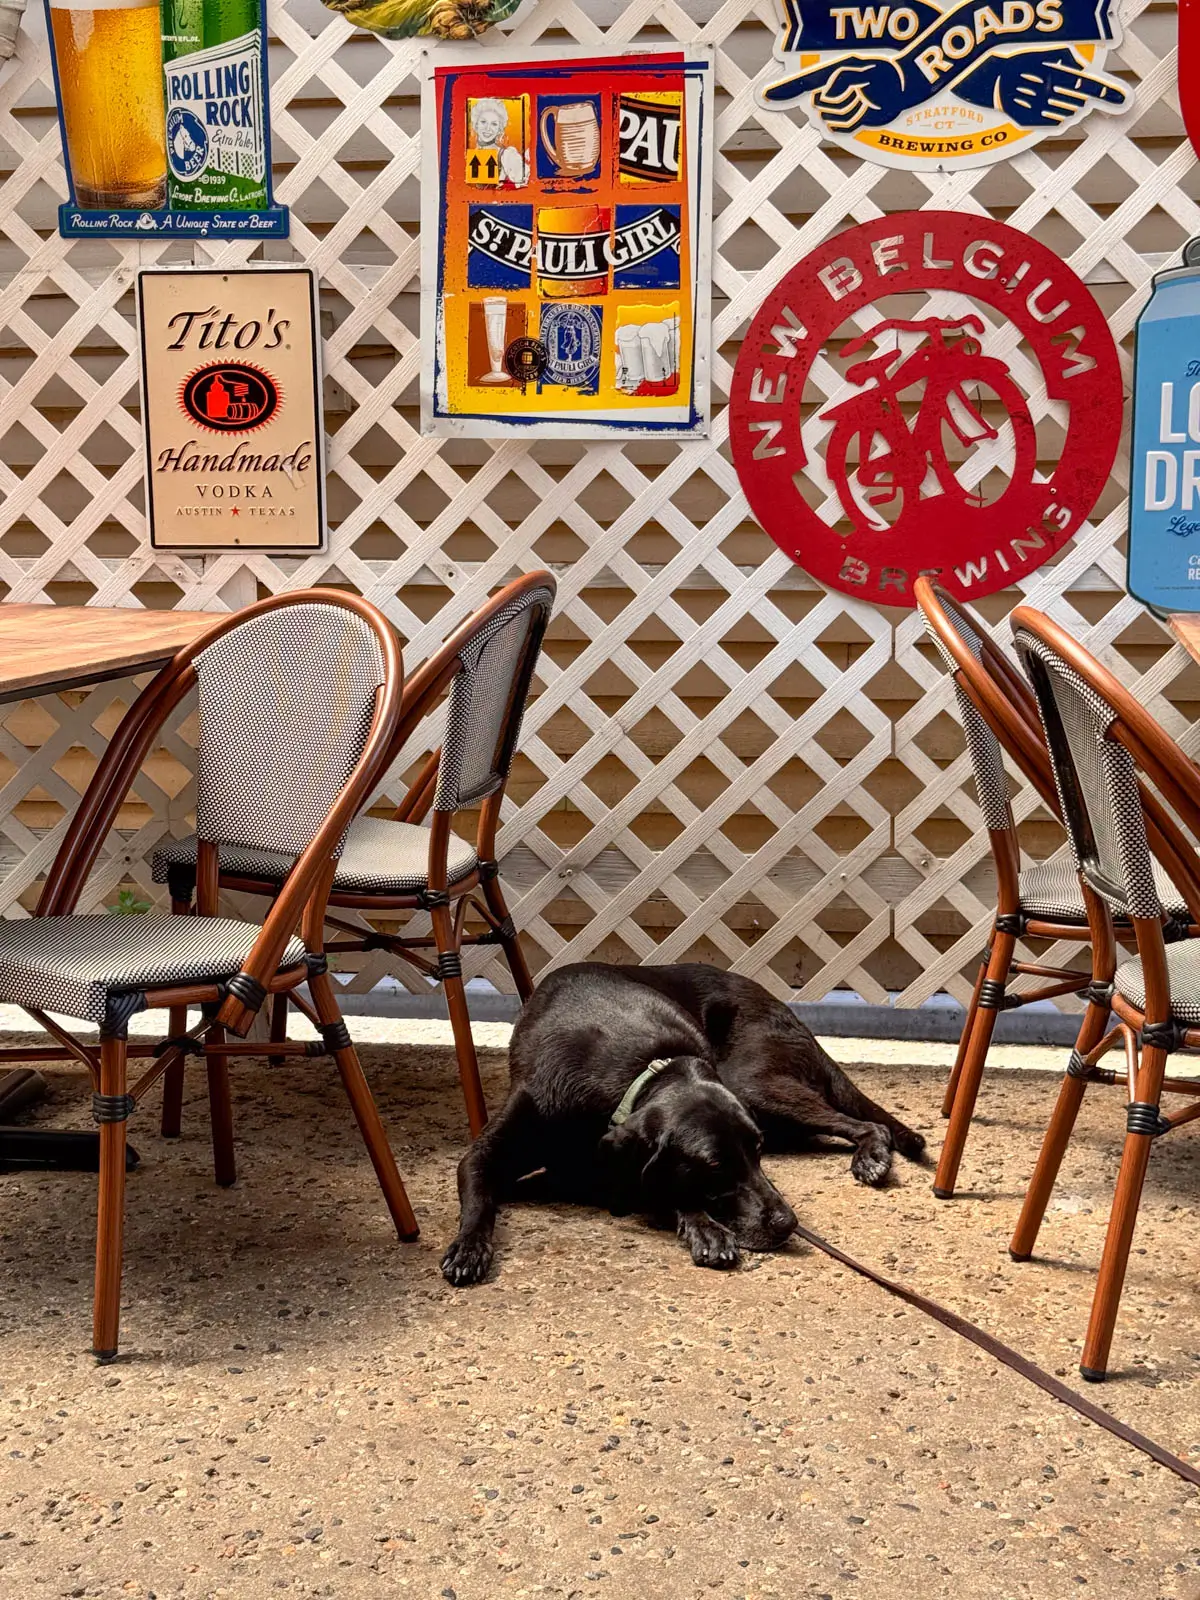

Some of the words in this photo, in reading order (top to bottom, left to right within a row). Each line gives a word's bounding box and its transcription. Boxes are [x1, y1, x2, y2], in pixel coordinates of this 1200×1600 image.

[830, 6, 920, 41] TWO
[913, 0, 1064, 84] ROADS
[171, 61, 250, 100] ROLLING
[205, 96, 253, 127] ROCK
[906, 106, 984, 126] STRATFORD
[934, 121, 955, 130] CT
[878, 134, 974, 153] BREWING
[980, 131, 1007, 146] CO
[184, 145, 205, 171] BEER
[70, 213, 108, 228] ROLLING
[108, 214, 134, 228] ROCK
[159, 214, 173, 230] A
[176, 214, 210, 229] UNIQUE
[212, 214, 236, 228] STATE
[505, 234, 599, 273] PAULI
[603, 215, 676, 266] GIRL
[167, 305, 291, 351] Tito's
[748, 304, 809, 461] NEW
[816, 232, 1098, 379] BELGIUM
[156, 440, 312, 473] Handmade
[195, 485, 273, 498] VODKA
[1145, 451, 1200, 511] DR
[176, 506, 222, 516] AUSTIN
[249, 507, 295, 516] TEXAS
